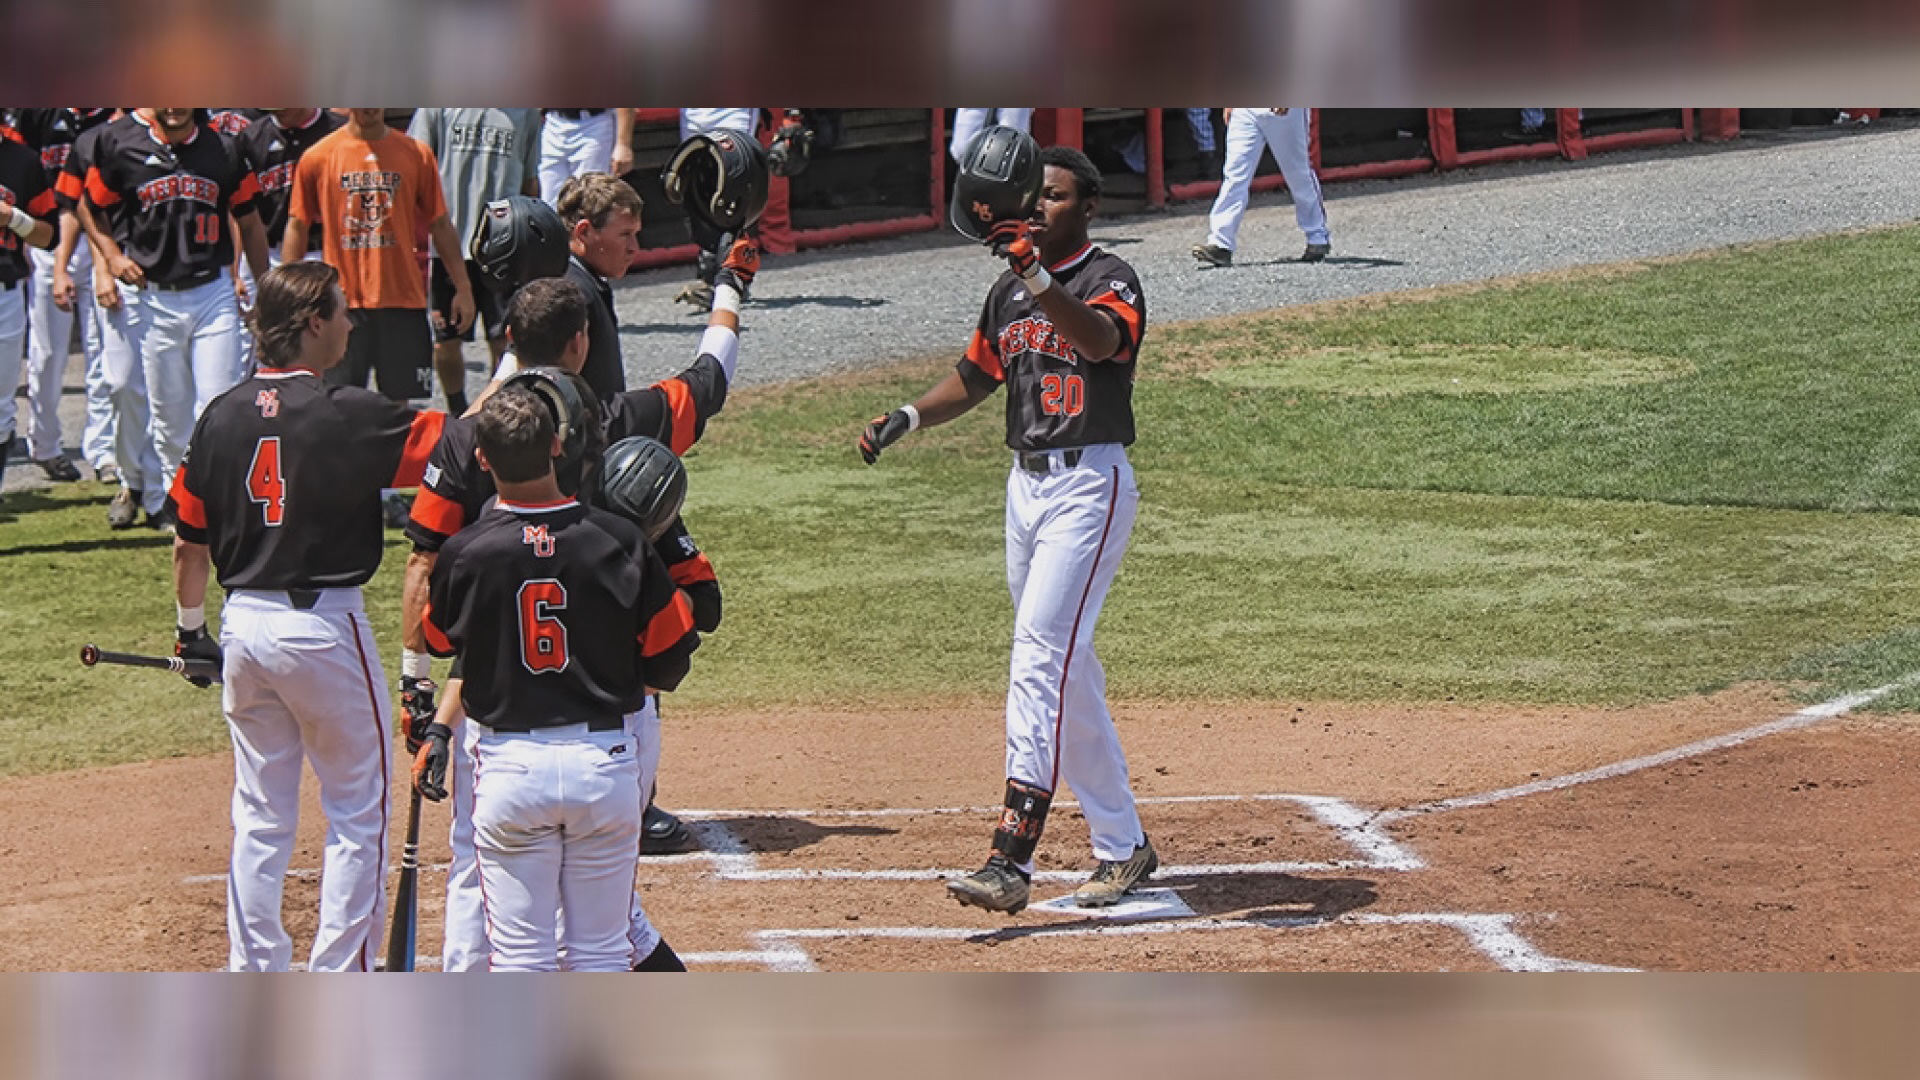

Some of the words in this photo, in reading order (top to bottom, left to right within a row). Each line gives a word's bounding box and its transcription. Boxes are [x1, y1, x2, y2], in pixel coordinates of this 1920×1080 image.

[136, 173, 219, 212] MERCER
[341, 172, 402, 189] MERCER
[194, 213, 219, 244] 10
[1040, 373, 1085, 417] 20
[245, 436, 286, 528] 4
[522, 524, 555, 558] MU
[516, 578, 570, 675] 6
